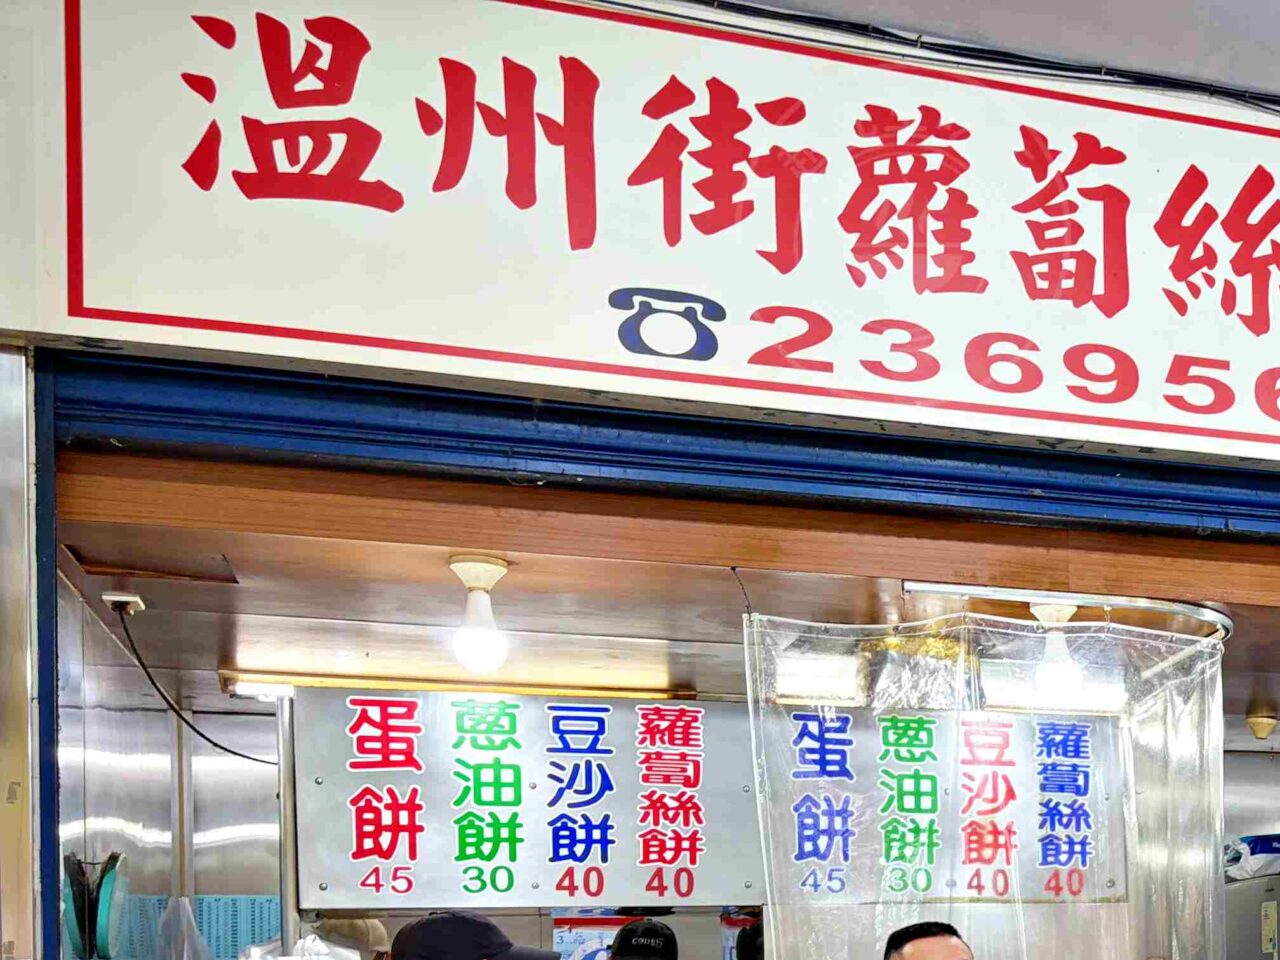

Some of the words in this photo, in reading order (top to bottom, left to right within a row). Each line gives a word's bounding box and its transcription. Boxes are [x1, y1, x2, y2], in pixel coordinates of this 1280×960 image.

[348, 698, 425, 862] 蛋餅
[546, 704, 616, 864] 豆沙餅
[637, 705, 704, 866] 蘿蔔絲餅
[791, 713, 856, 863] 蛋餅
[960, 719, 1018, 867] 豆沙餅
[1036, 720, 1094, 868] 蘿蔔絲餅
[360, 866, 414, 894] 45
[463, 866, 515, 894] 30
[555, 867, 605, 897] 40
[645, 867, 695, 897] 40
[800, 868, 846, 893] 45
[888, 867, 933, 893] 30
[967, 868, 1010, 897] 40
[1043, 867, 1085, 897] 40
